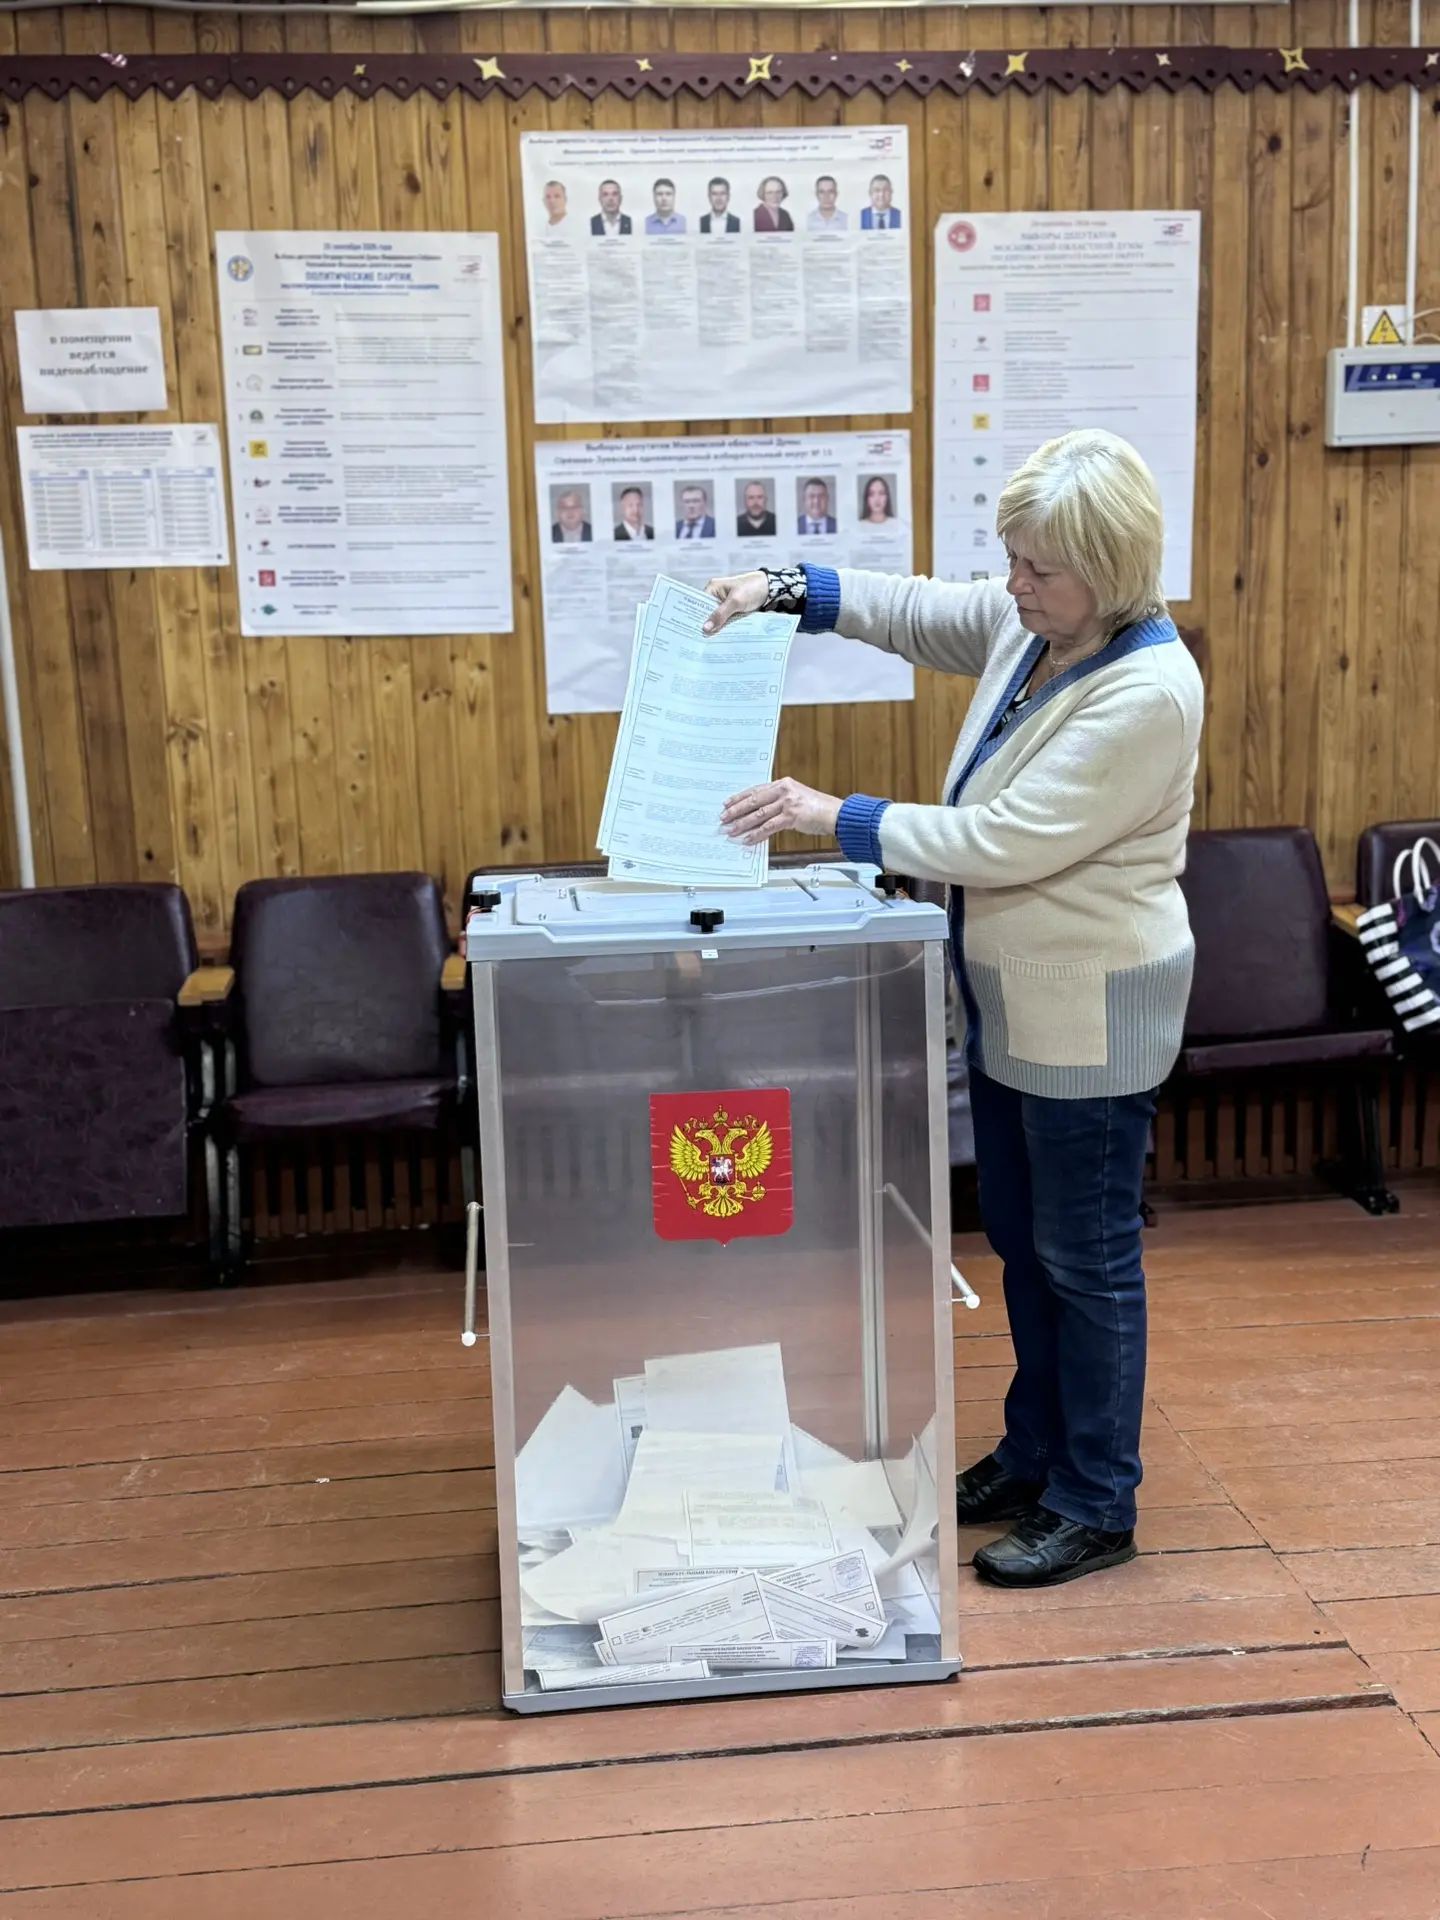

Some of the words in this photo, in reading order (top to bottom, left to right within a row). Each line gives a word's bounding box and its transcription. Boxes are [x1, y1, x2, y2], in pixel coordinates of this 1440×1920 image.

[60, 335, 132, 346] помещении
[69, 351, 116, 360] ведется
[39, 363, 149, 377] видеонаблюдение
[585, 443, 623, 452] Выборы
